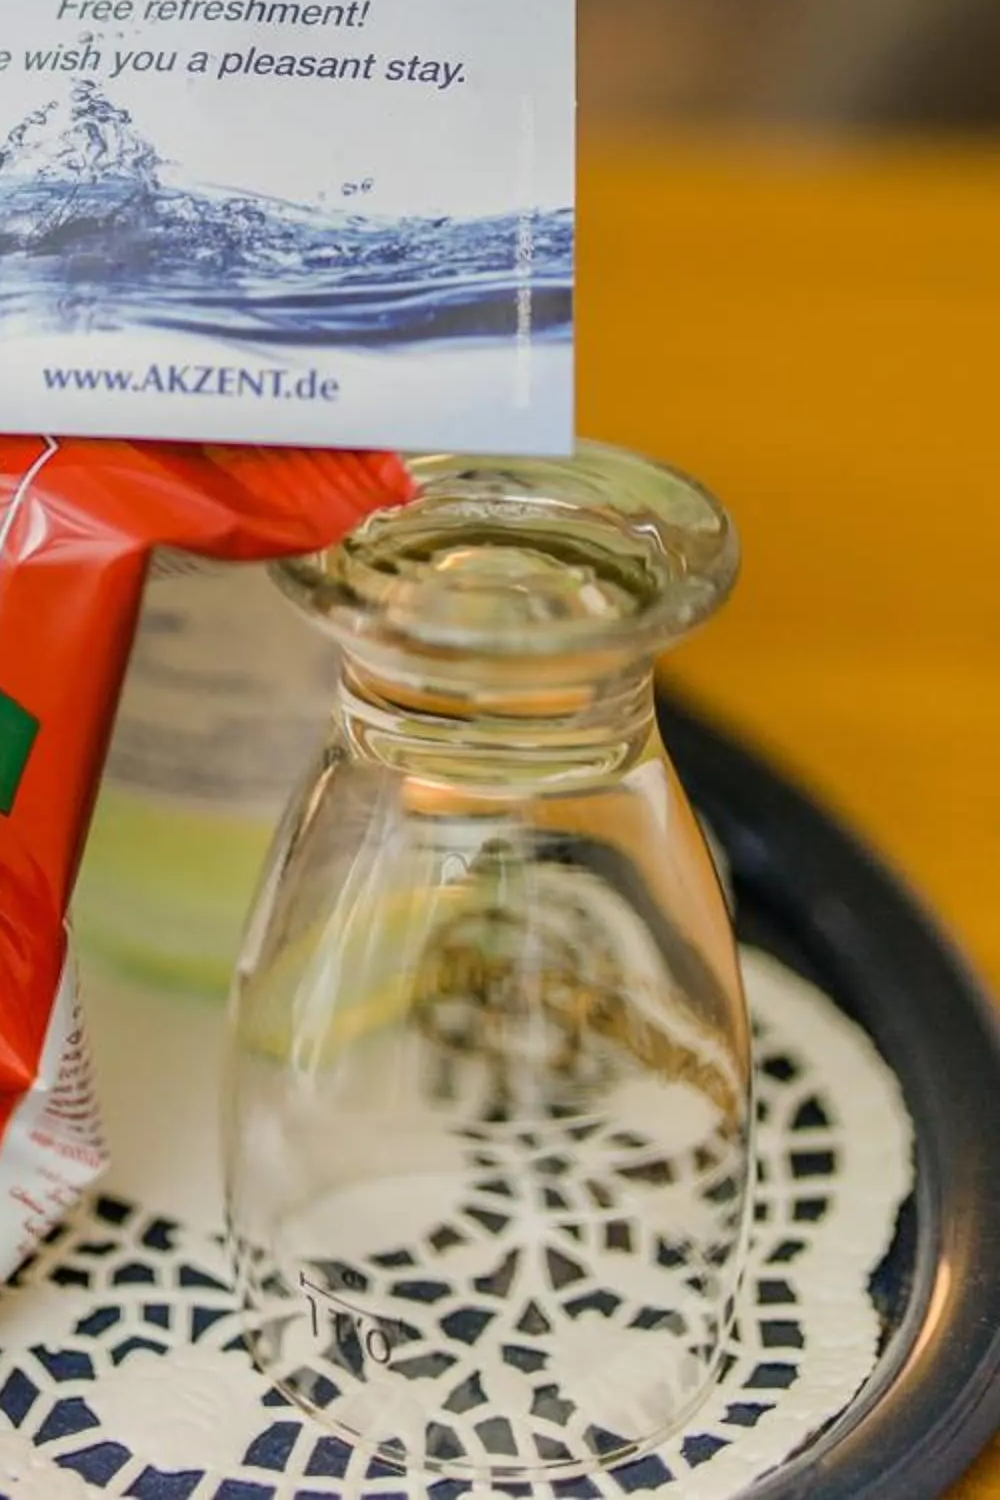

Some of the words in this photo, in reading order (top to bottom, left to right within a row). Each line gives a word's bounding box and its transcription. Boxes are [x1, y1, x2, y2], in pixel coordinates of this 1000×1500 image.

[25, 44, 101, 72] wish
[109, 51, 177, 80] you
[186, 52, 209, 74] a
[217, 46, 376, 82] pleasant
[385, 56, 464, 90] stay.
[43, 364, 340, 400] www.AKZENT.de
